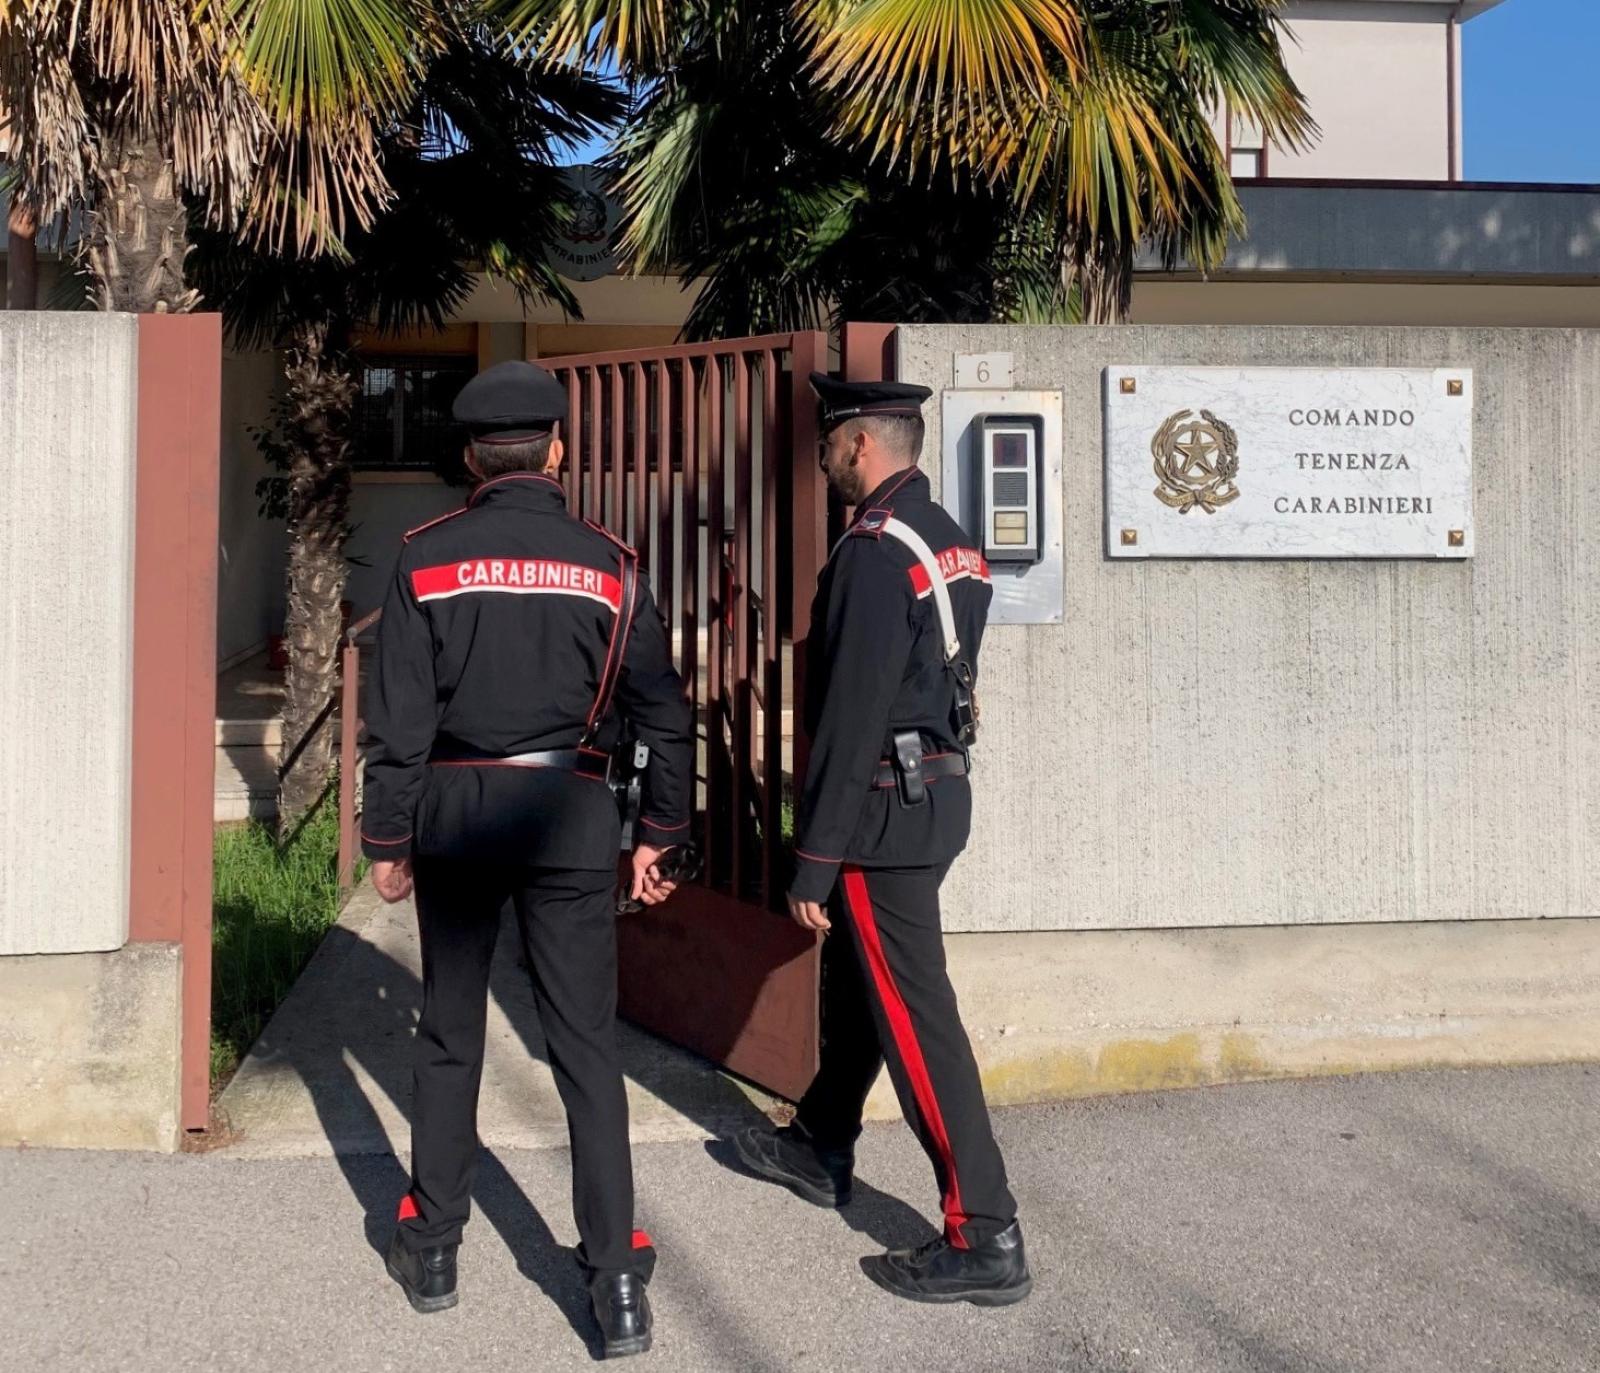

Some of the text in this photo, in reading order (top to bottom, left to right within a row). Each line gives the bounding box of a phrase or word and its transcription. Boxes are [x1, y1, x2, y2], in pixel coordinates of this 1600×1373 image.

[977, 360, 990, 383] 6
[1288, 409, 1415, 427] COMANDO
[1294, 452, 1410, 471] TENENZA
[1273, 496, 1433, 515] CARABINIERI
[456, 561, 603, 593] CARABINIERI
